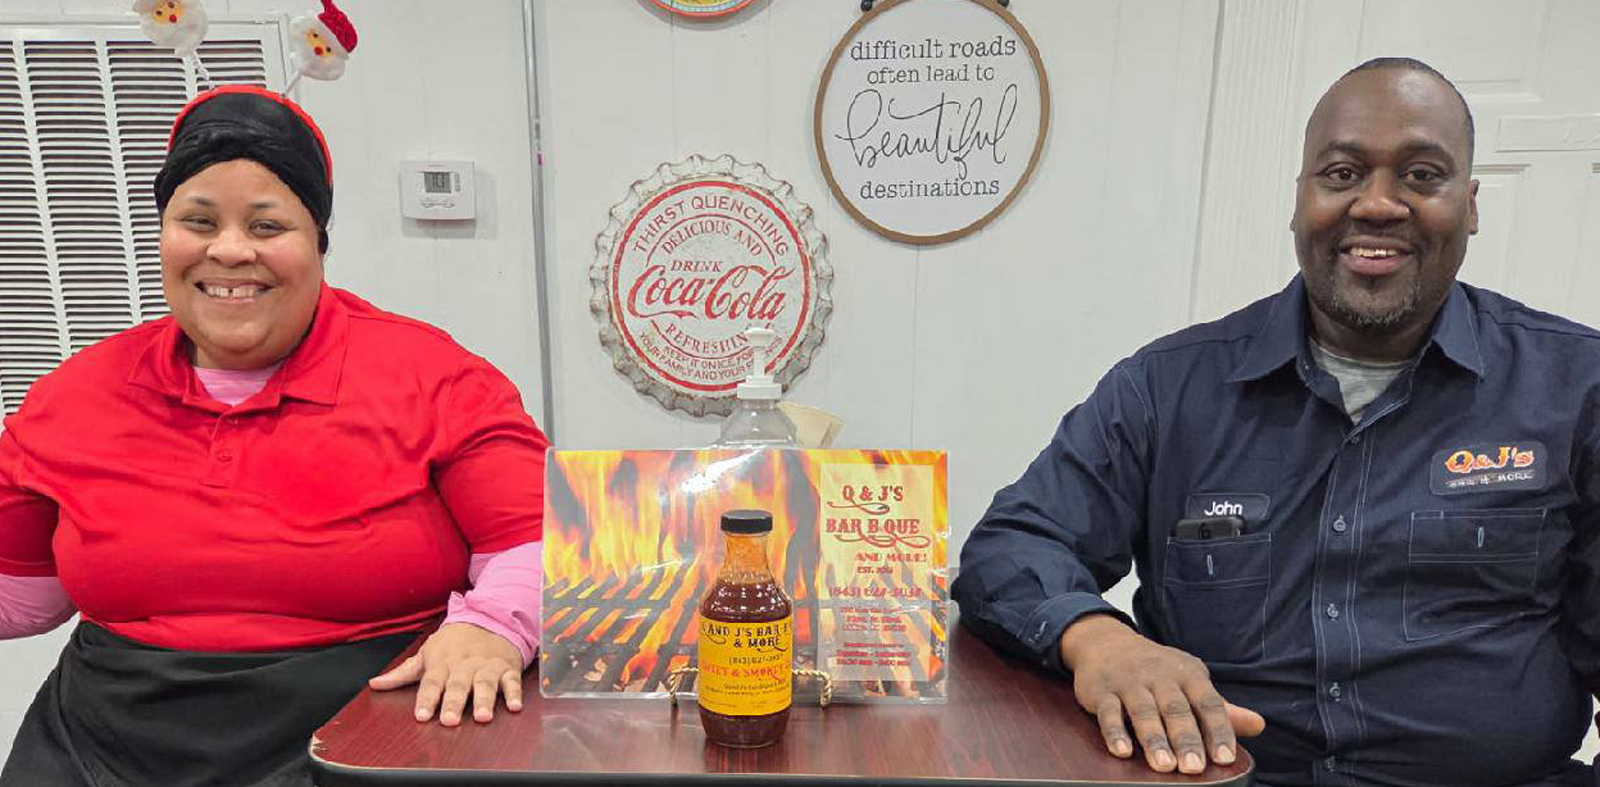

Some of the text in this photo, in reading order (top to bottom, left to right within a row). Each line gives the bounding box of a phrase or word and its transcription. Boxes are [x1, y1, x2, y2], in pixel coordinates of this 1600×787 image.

[850, 36, 1016, 60] difficult roads
[867, 64, 995, 84] often lead to
[835, 83, 1017, 180] beautiful
[860, 178, 1000, 199] destinations
[634, 196, 789, 256] THIRST QUENCHING
[661, 219, 763, 257] DELICIOUS AND
[670, 260, 724, 273] DRINK
[627, 265, 795, 320] Coca-Cola
[665, 323, 752, 354] REFRESHIN
[694, 370, 718, 380] AND
[719, 366, 745, 379] YOUR
[1498, 472, 1533, 482] MORE
[860, 485, 873, 501] &
[878, 485, 904, 501] J'S
[1204, 500, 1243, 516] John
[825, 519, 863, 535] BAR
[884, 519, 920, 536] QUE
[707, 624, 730, 637] AND
[735, 627, 752, 637] J'S
[733, 636, 781, 648] & MORE
